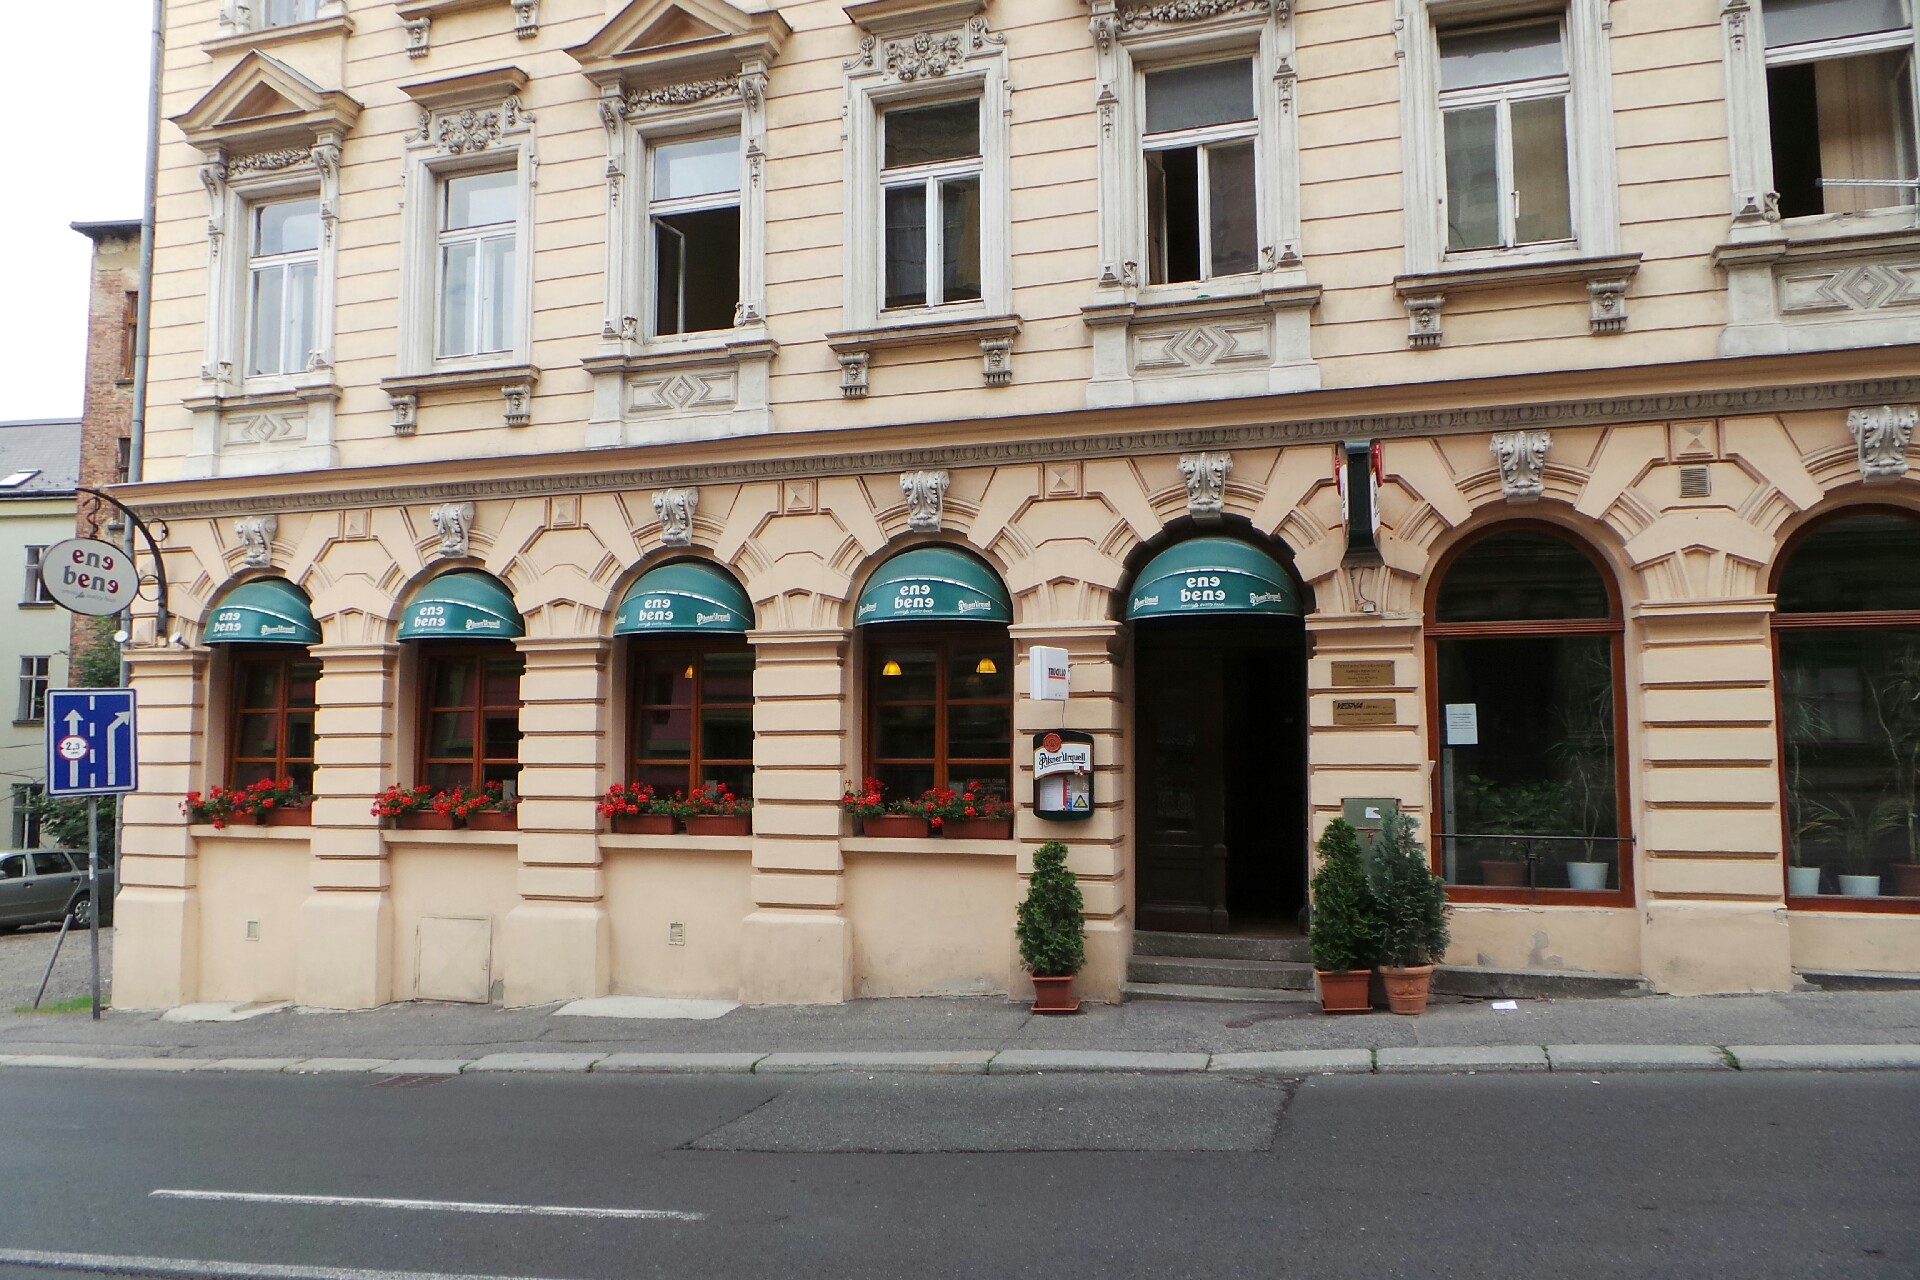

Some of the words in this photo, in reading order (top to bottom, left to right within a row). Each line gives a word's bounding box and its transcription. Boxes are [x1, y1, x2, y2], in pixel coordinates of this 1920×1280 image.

[63, 565, 119, 594] bene
[1180, 589, 1226, 602] bene
[894, 596, 935, 609] bene
[638, 609, 674, 621] bene
